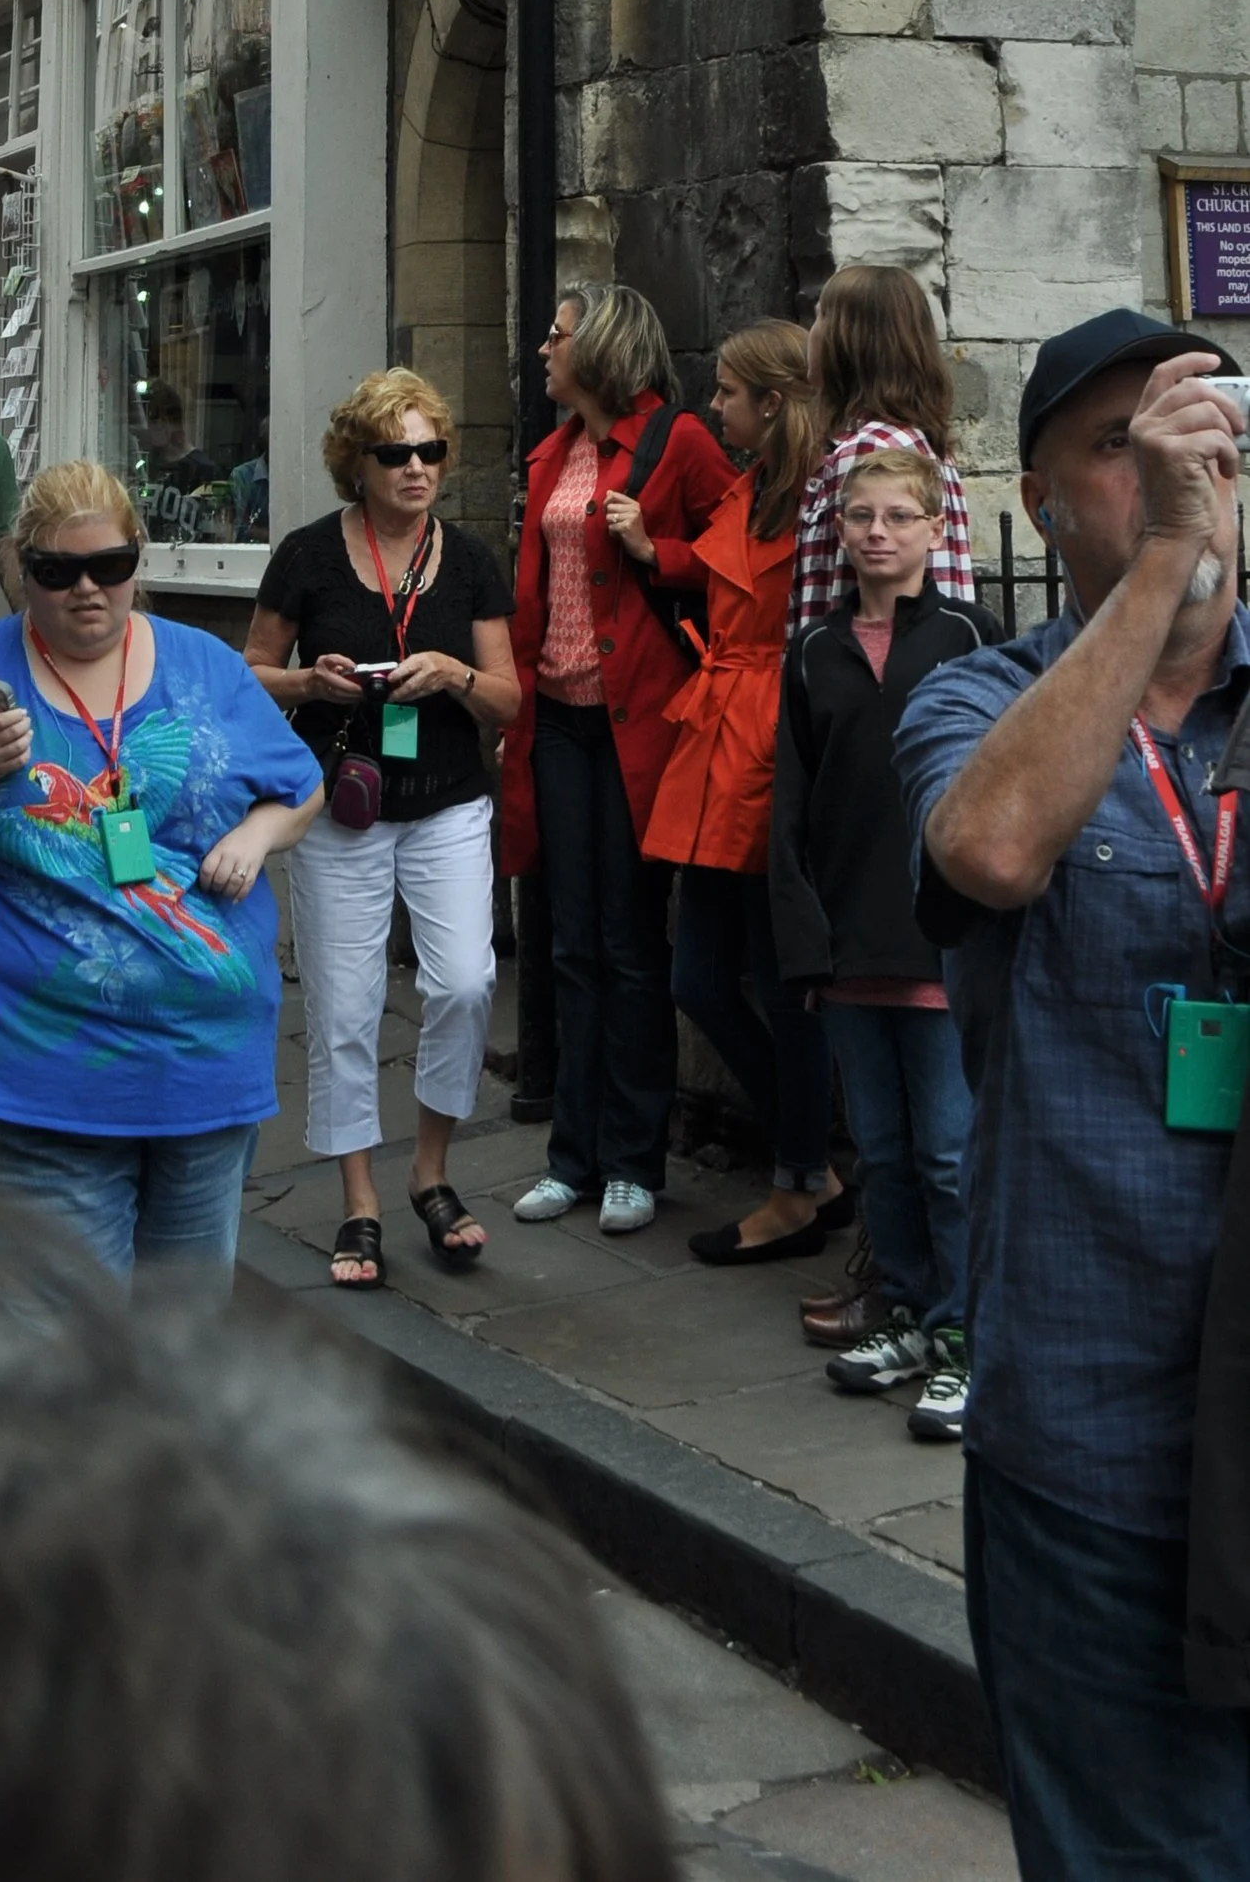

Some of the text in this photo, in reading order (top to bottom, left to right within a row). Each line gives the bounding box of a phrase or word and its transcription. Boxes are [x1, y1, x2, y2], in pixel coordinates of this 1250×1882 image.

[1231, 183, 1250, 197] CR
[1196, 198, 1250, 213] CHURCH
[1196, 222, 1216, 233] THIS
[1217, 222, 1242, 233] LAND
[1219, 240, 1234, 251] No
[1228, 282, 1249, 293] may
[1130, 717, 1160, 770] AFALGAR
[1215, 810, 1232, 886] TRAFALGAR
